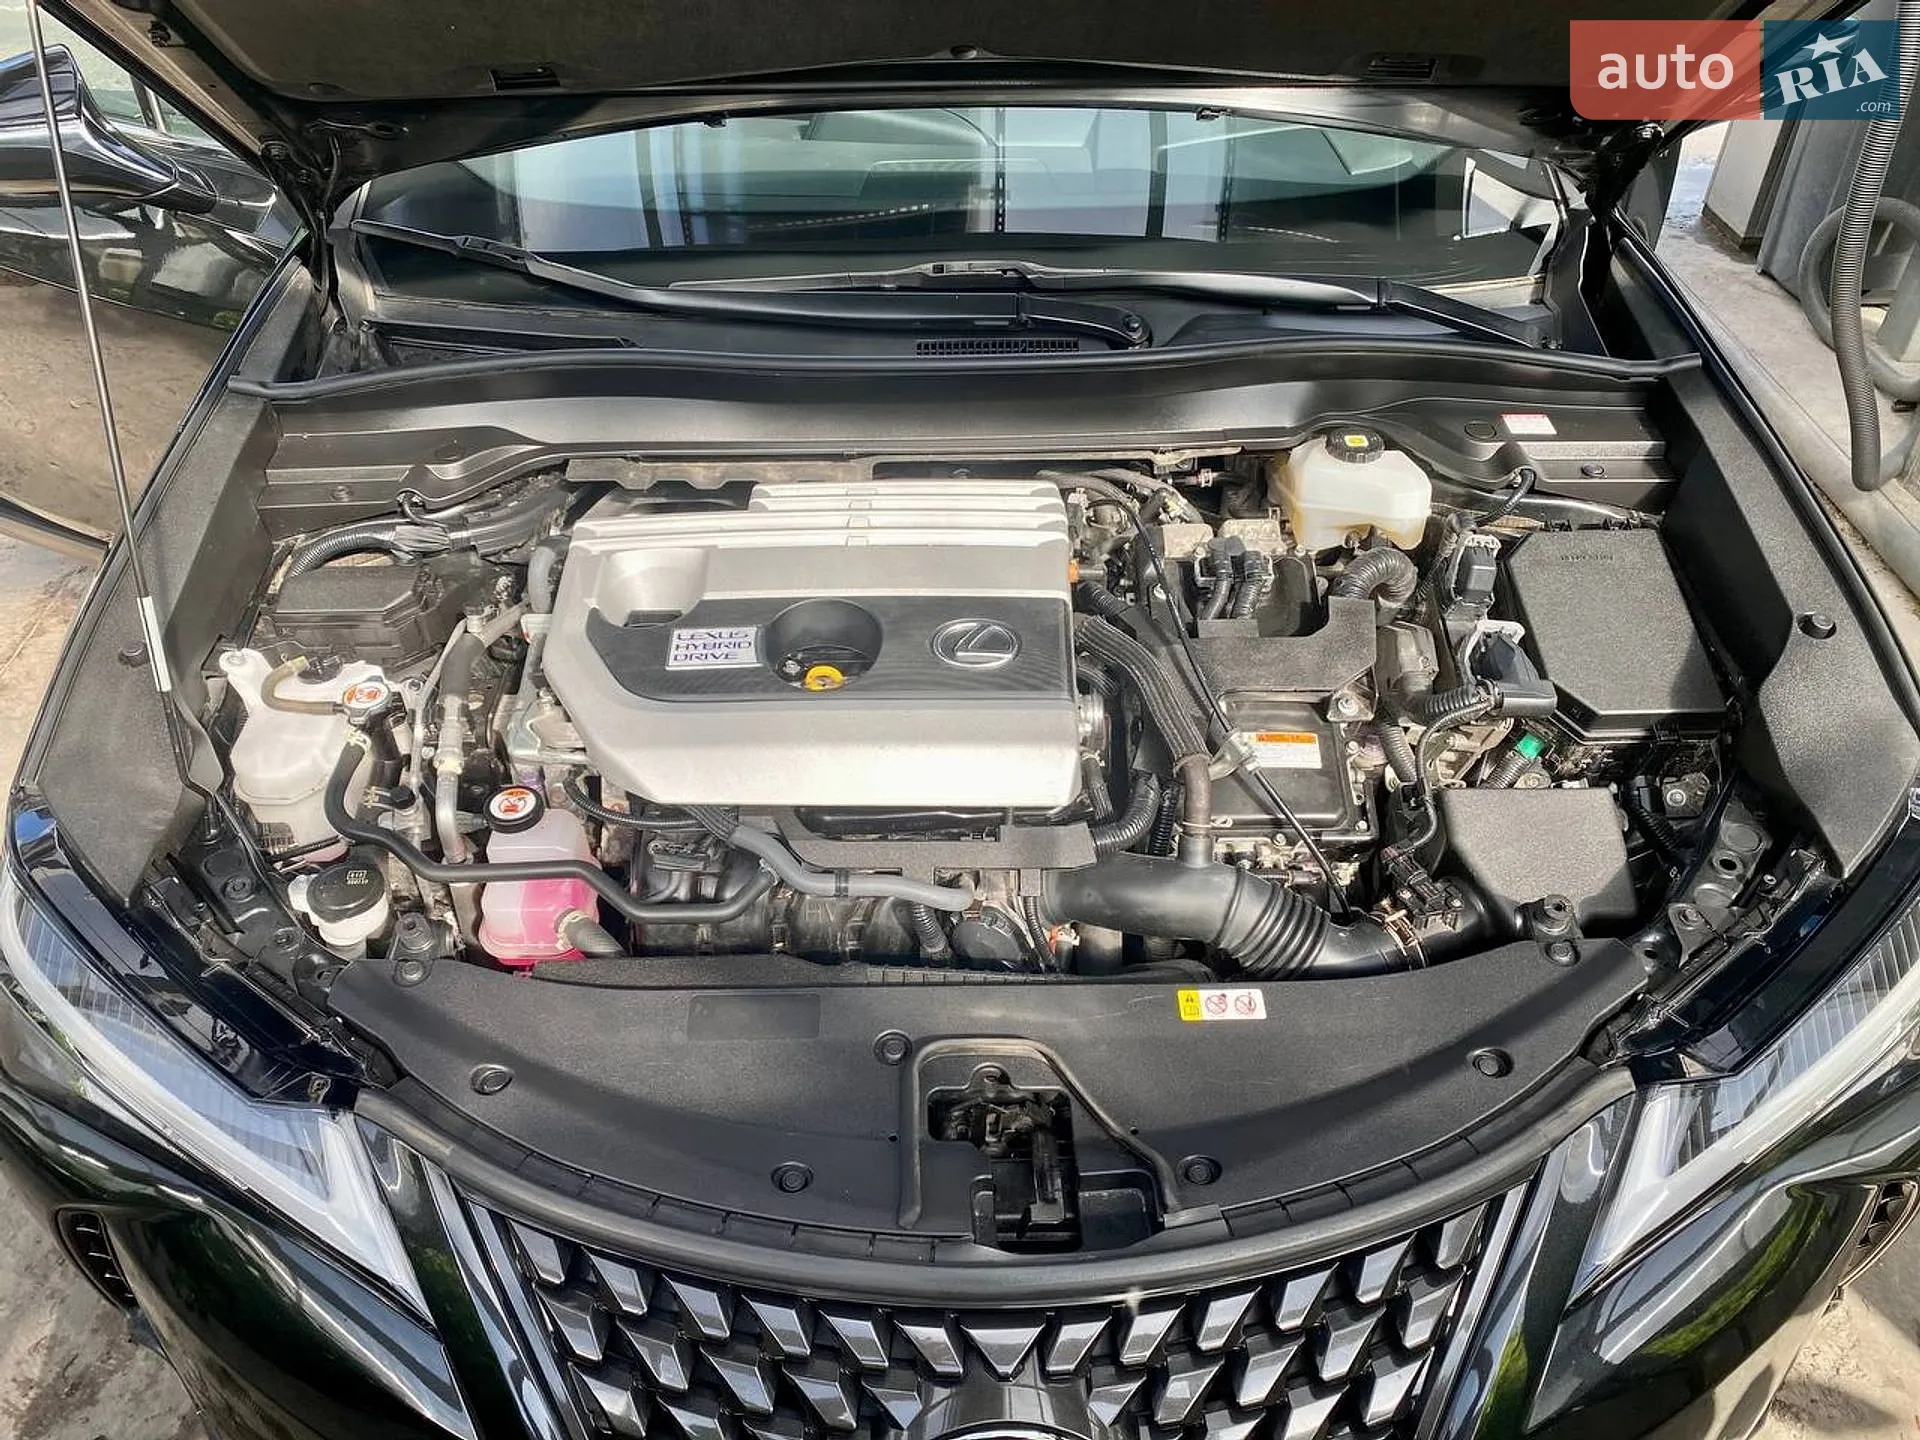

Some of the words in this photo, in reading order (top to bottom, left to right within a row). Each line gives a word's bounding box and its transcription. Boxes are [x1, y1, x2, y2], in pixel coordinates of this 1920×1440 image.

[677, 631, 749, 640] LEXUS
[676, 641, 751, 651] HYBRID
[674, 652, 738, 661] DRIVE
